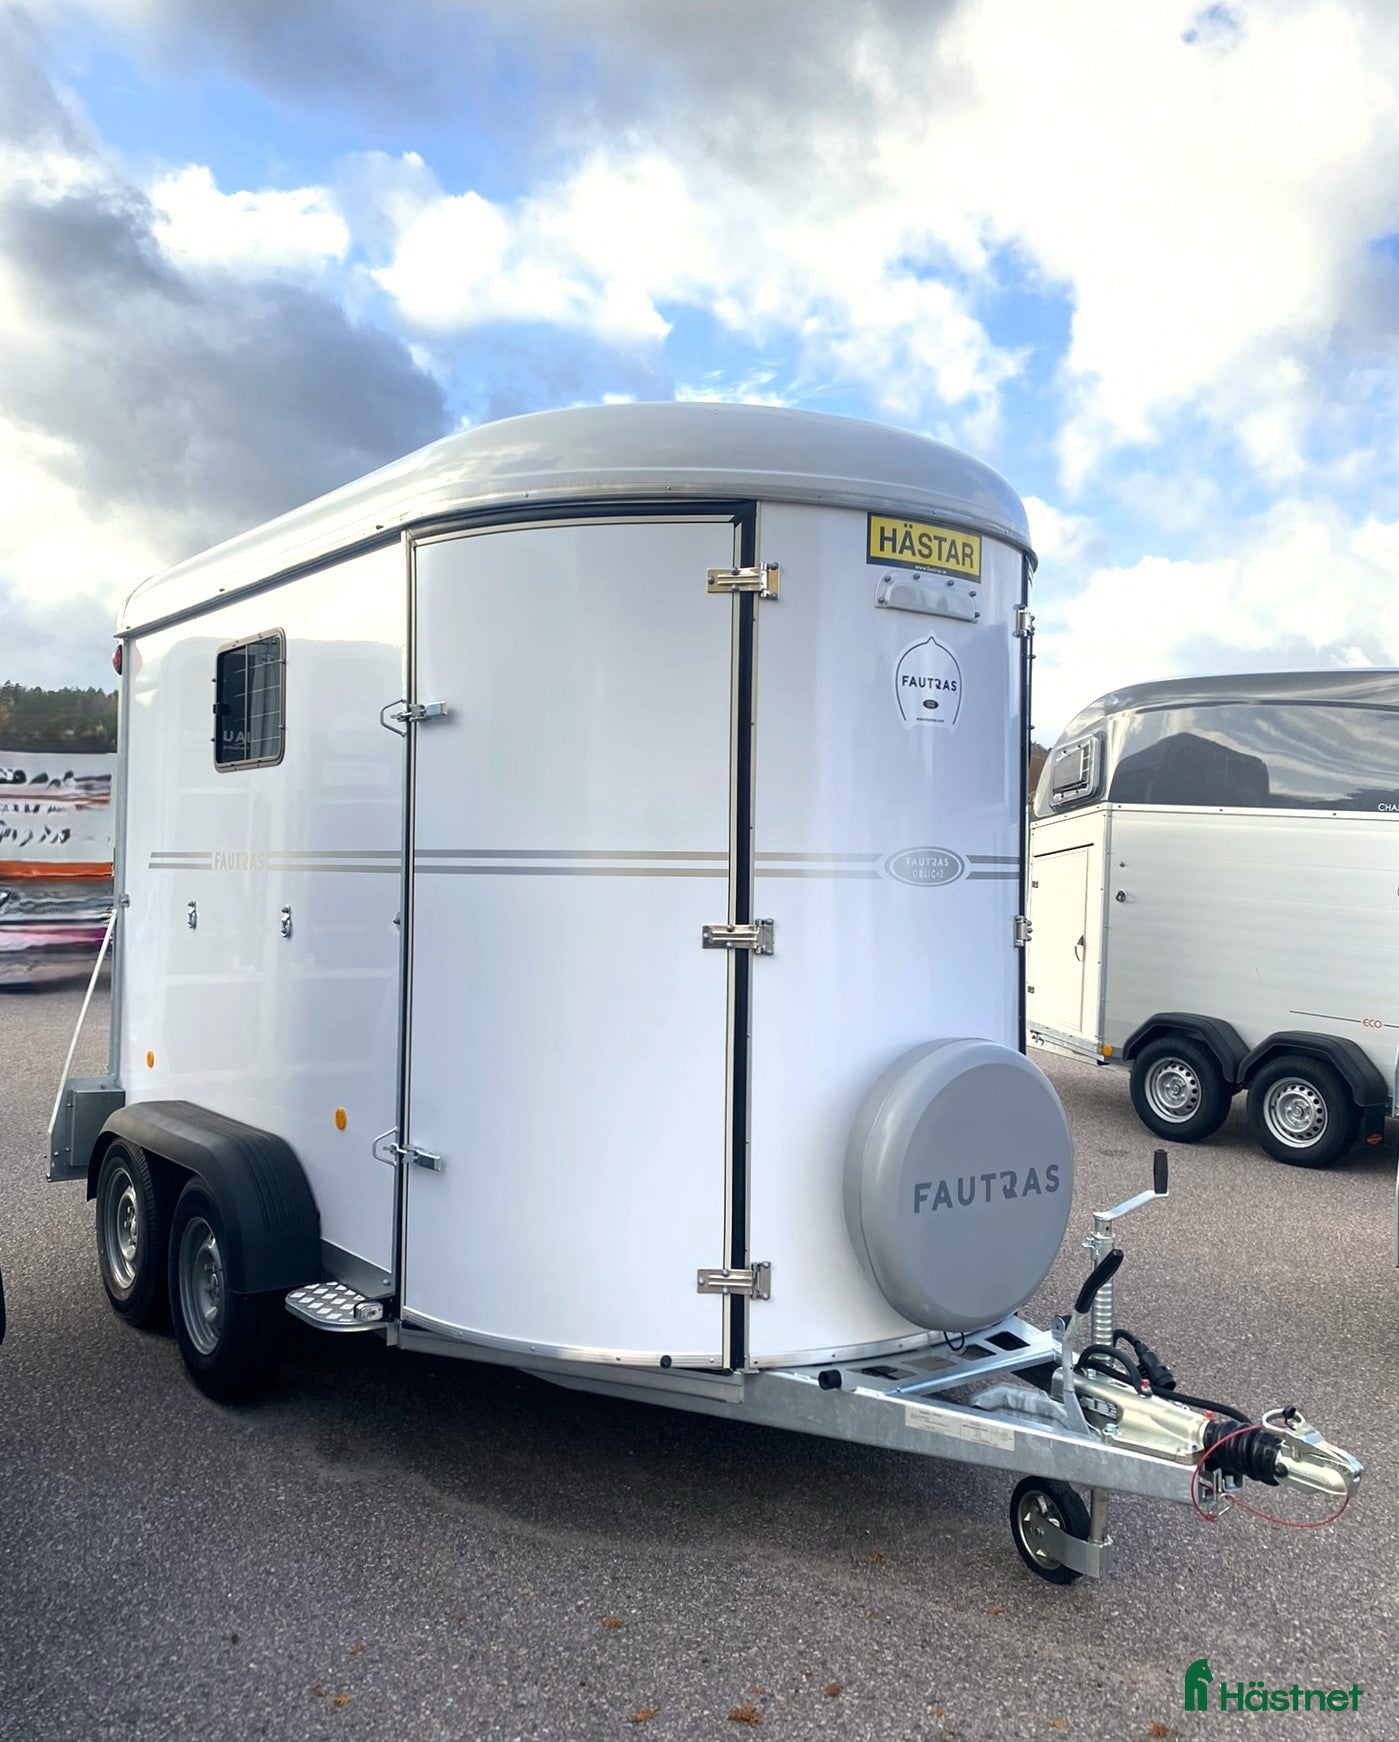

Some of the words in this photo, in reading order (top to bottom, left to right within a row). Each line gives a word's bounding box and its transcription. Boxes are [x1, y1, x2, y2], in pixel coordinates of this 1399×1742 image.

[879, 523, 975, 569] HÄSTAR
[902, 675, 957, 692] FAUTRAS
[905, 856, 949, 868] FAUTRAS
[1363, 1019, 1382, 1029] ECO
[914, 1164, 1060, 1214] FAUTRAS
